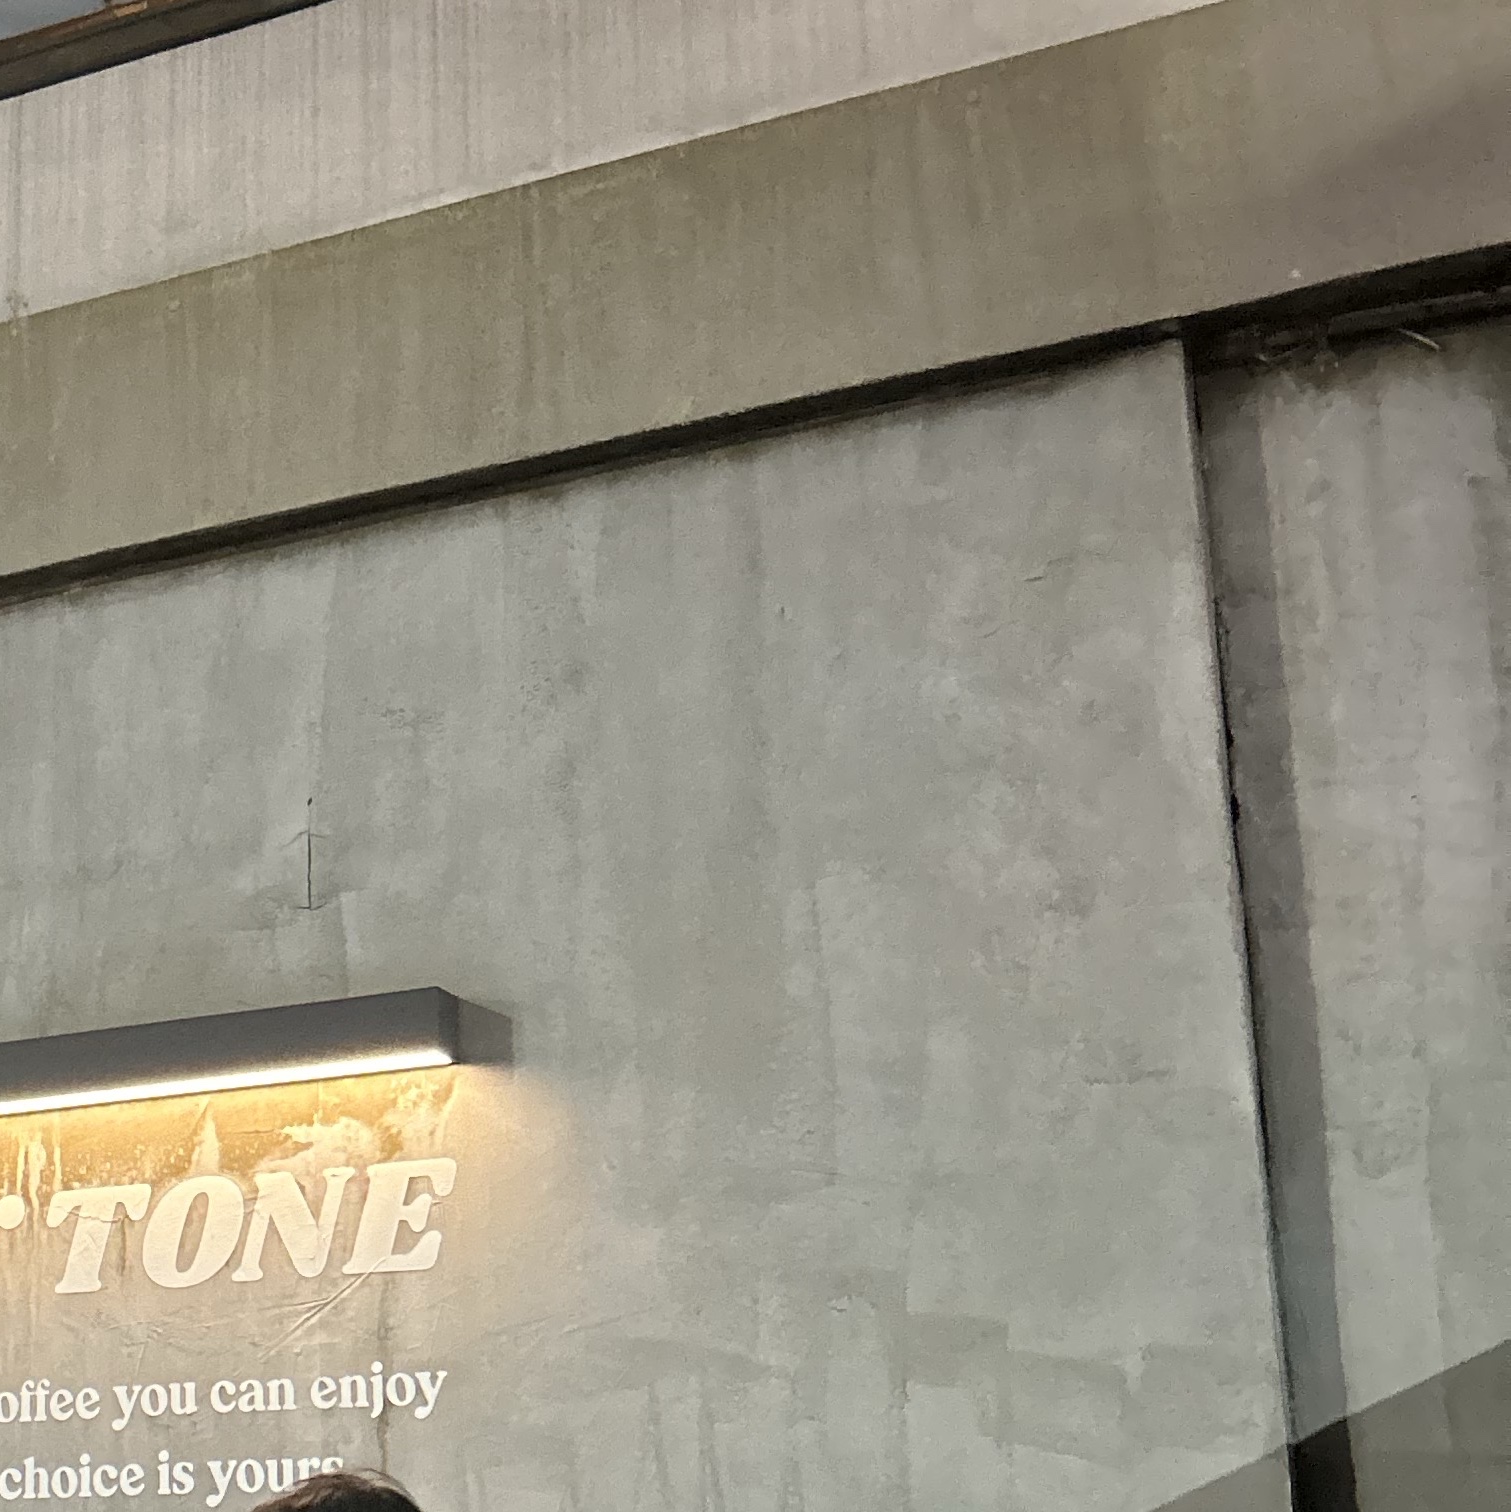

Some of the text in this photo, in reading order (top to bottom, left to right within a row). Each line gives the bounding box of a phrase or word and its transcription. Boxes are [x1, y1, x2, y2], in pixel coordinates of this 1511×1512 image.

[46, 1156, 458, 1294] TONE
[111, 1380, 198, 1431] you
[210, 1378, 296, 1414] can
[310, 1361, 448, 1420] enjoy
[157, 1450, 195, 1496] is
